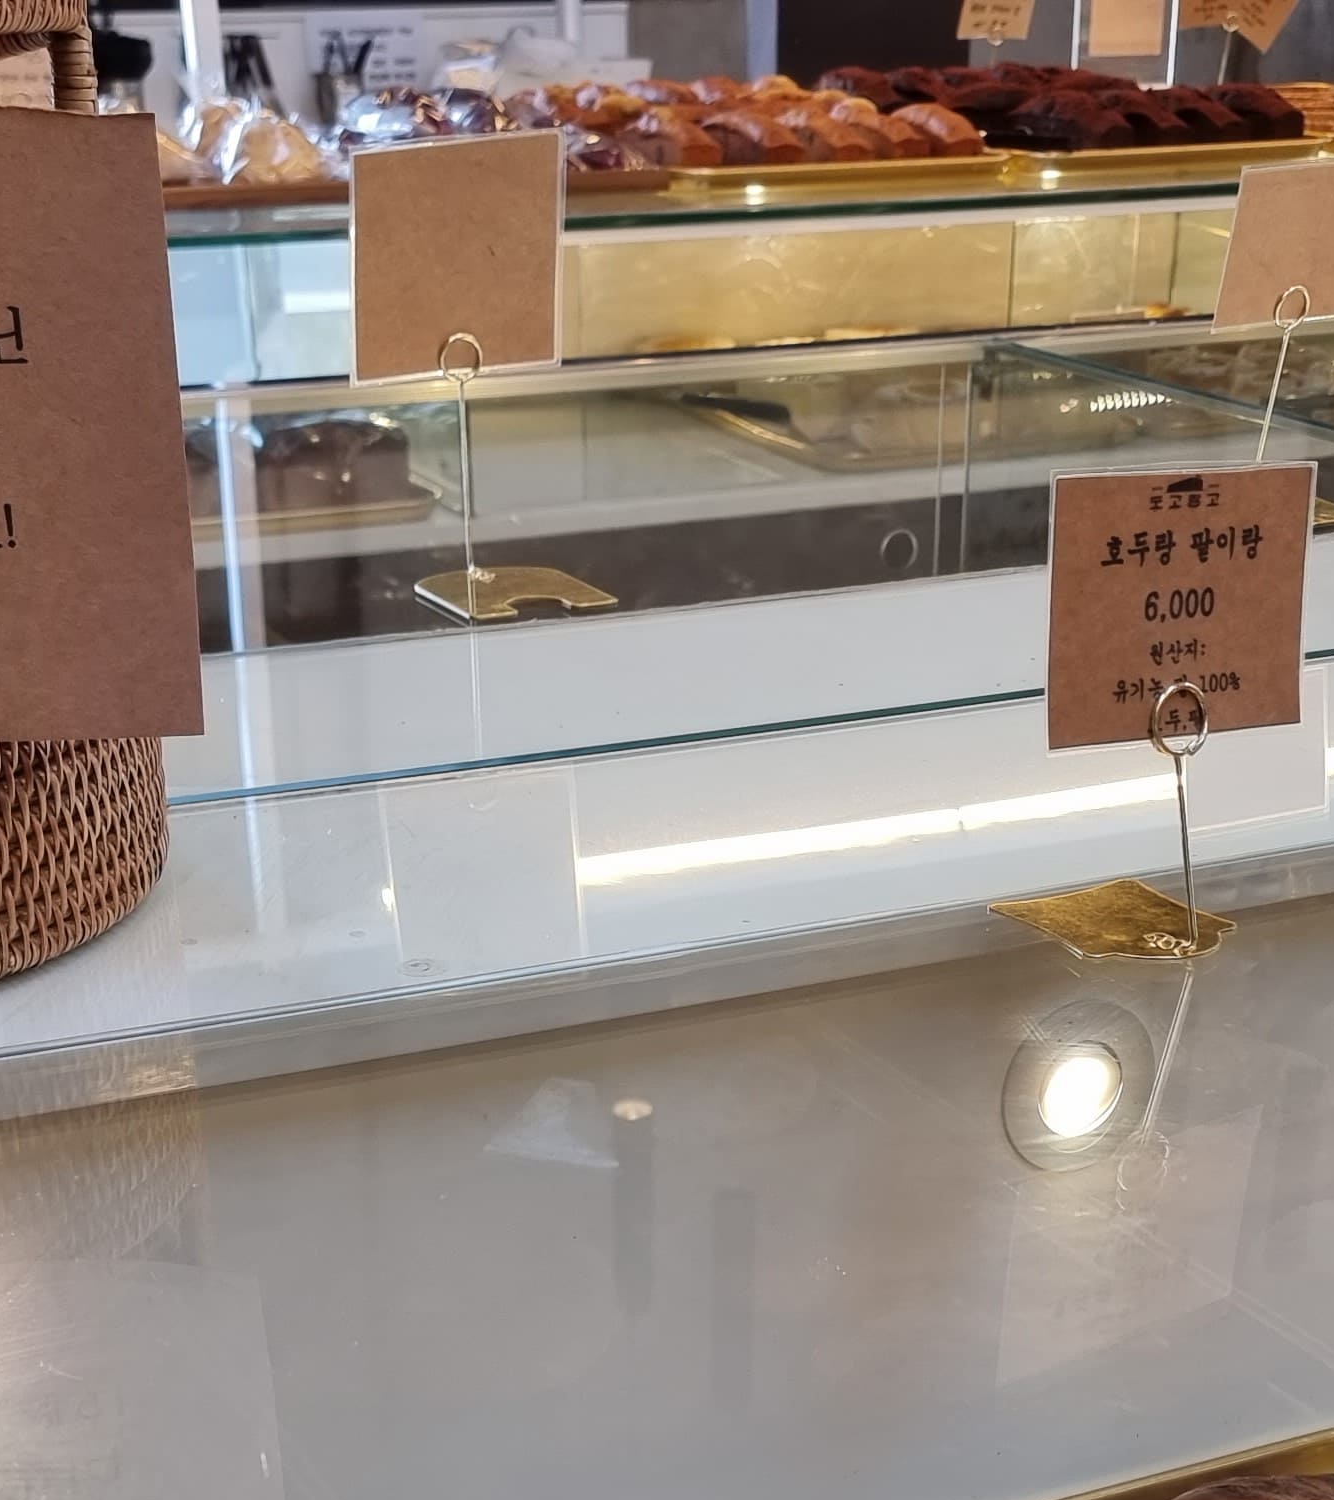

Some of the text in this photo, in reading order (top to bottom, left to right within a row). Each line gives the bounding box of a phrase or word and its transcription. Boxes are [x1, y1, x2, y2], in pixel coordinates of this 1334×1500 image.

[1101, 524, 1263, 567] 호두랑 팥이랑
[1144, 587, 1215, 622] 6,000
[1149, 639, 1206, 666] 원산지:
[1199, 672, 1241, 694] 100%
